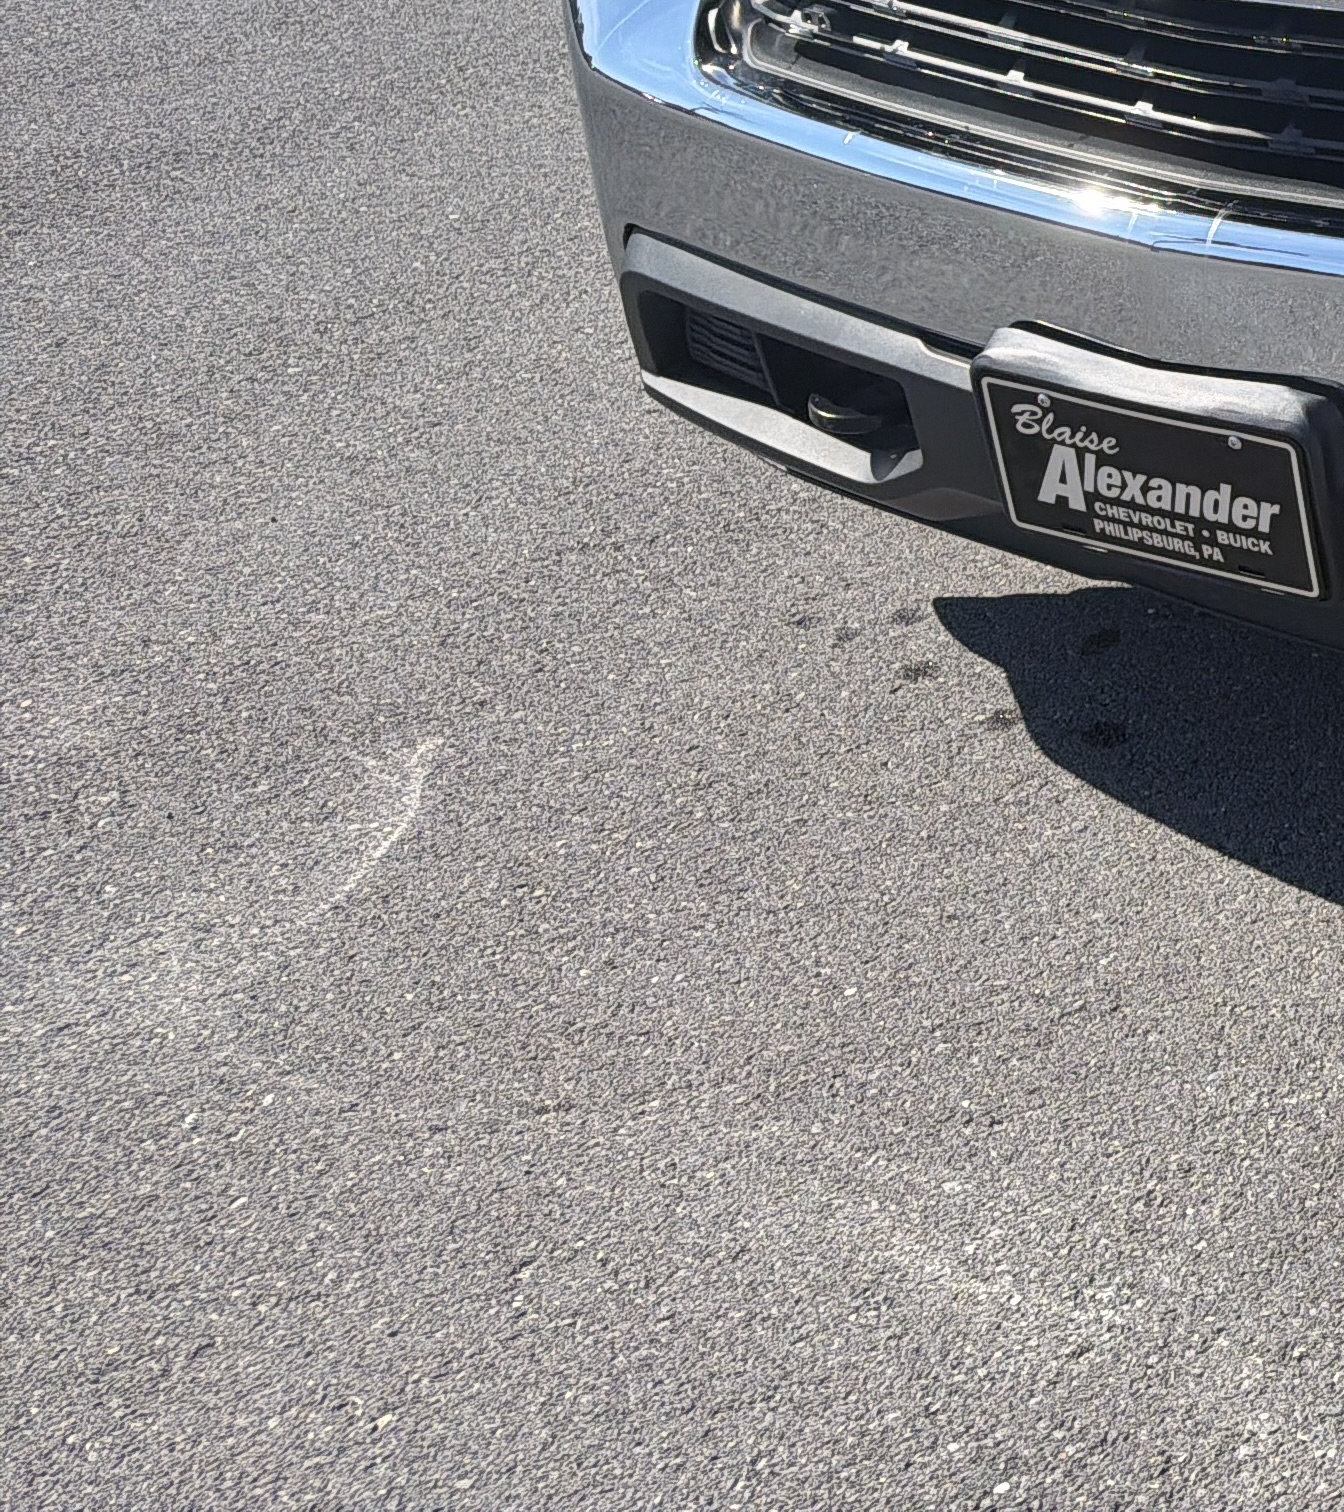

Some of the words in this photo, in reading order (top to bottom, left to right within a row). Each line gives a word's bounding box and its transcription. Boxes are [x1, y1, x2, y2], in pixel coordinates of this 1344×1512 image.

[1010, 402, 1120, 456] Blaise
[1037, 443, 1281, 535] Alexander
[1093, 517, 1200, 560] PHILIPSBURG,
[1201, 544, 1225, 563] PA
[1094, 500, 1196, 538] CHEVROLET
[1216, 530, 1274, 556] BUICK
